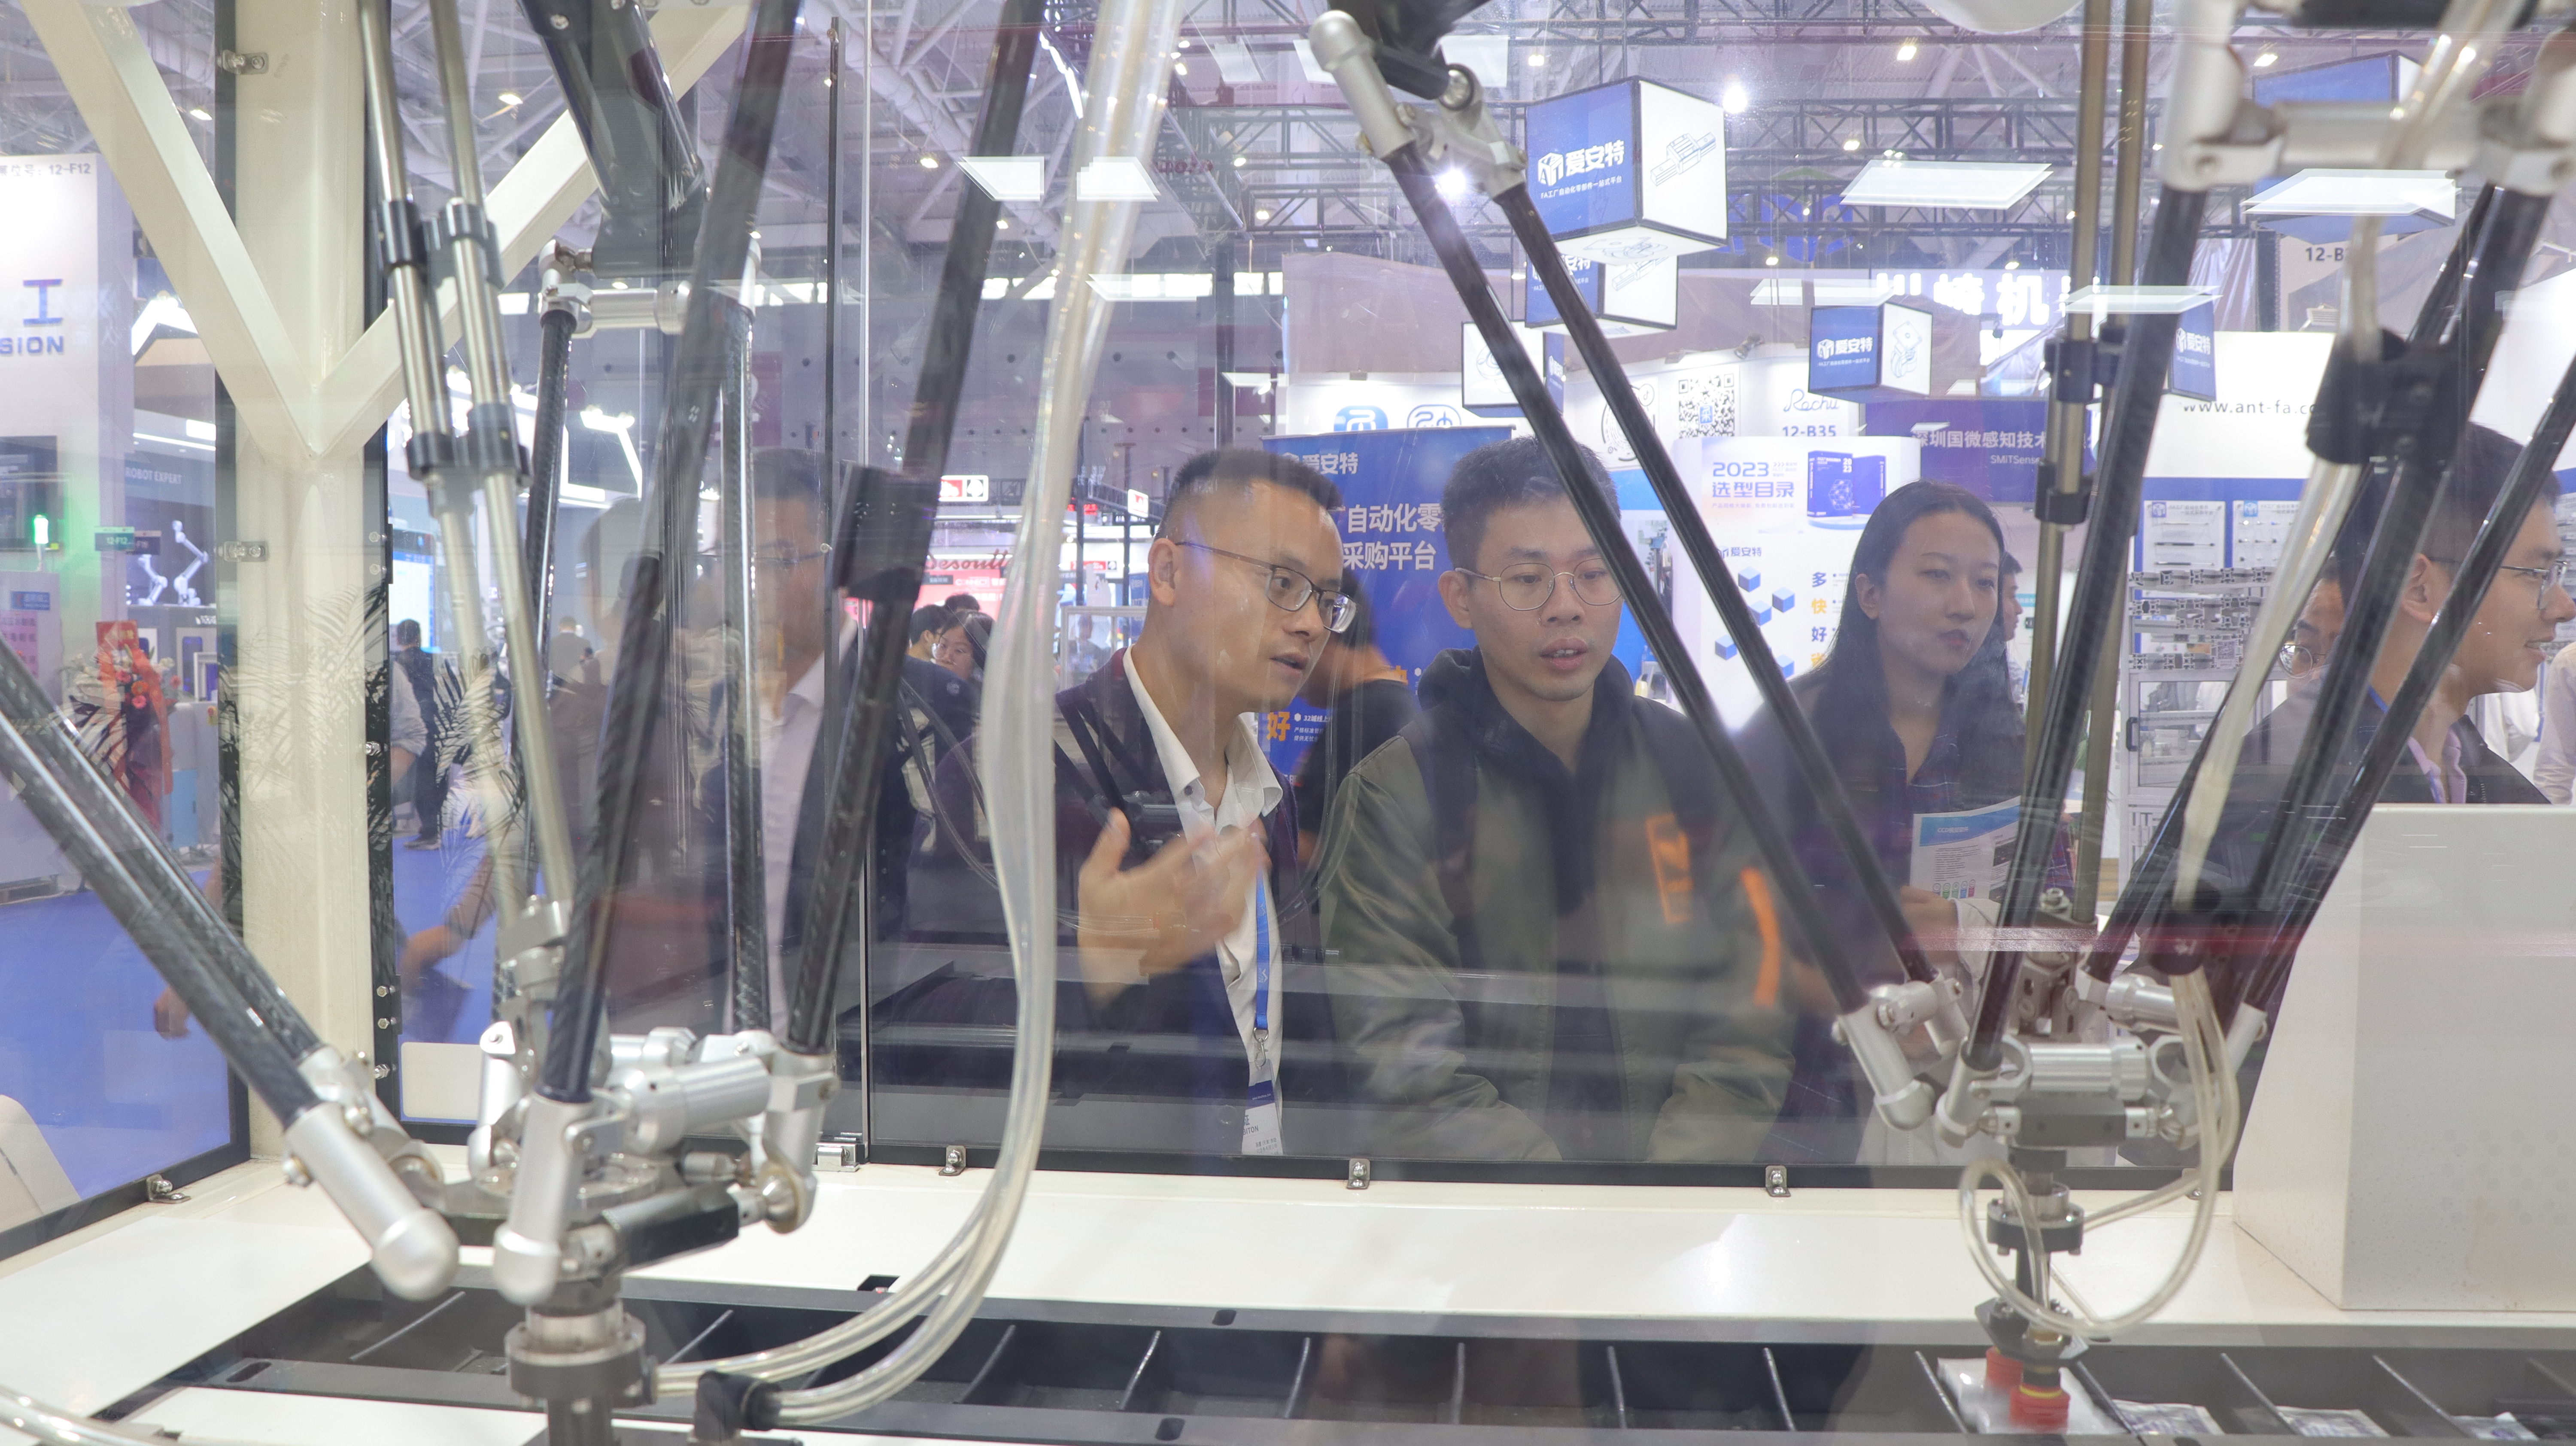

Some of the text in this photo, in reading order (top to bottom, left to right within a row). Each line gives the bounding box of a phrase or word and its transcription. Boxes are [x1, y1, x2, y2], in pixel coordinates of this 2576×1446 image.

[1566, 140, 1625, 177] 爱安特
[2305, 246, 2347, 261] 12-B
[0, 336, 64, 355] SION
[1835, 336, 1873, 355] 爱安特
[1782, 424, 1836, 436] 12-B35
[1713, 462, 1769, 477] 2023
[1713, 481, 1795, 498] 选型目录
[1337, 502, 1442, 533] 自动化零
[1343, 540, 1437, 571] 采购平台
[1731, 547, 1762, 557] 爱安特
[1812, 571, 1827, 587] 多
[1811, 598, 1827, 614] 快
[1812, 626, 1827, 642] 好
[1267, 711, 1291, 741] 好
